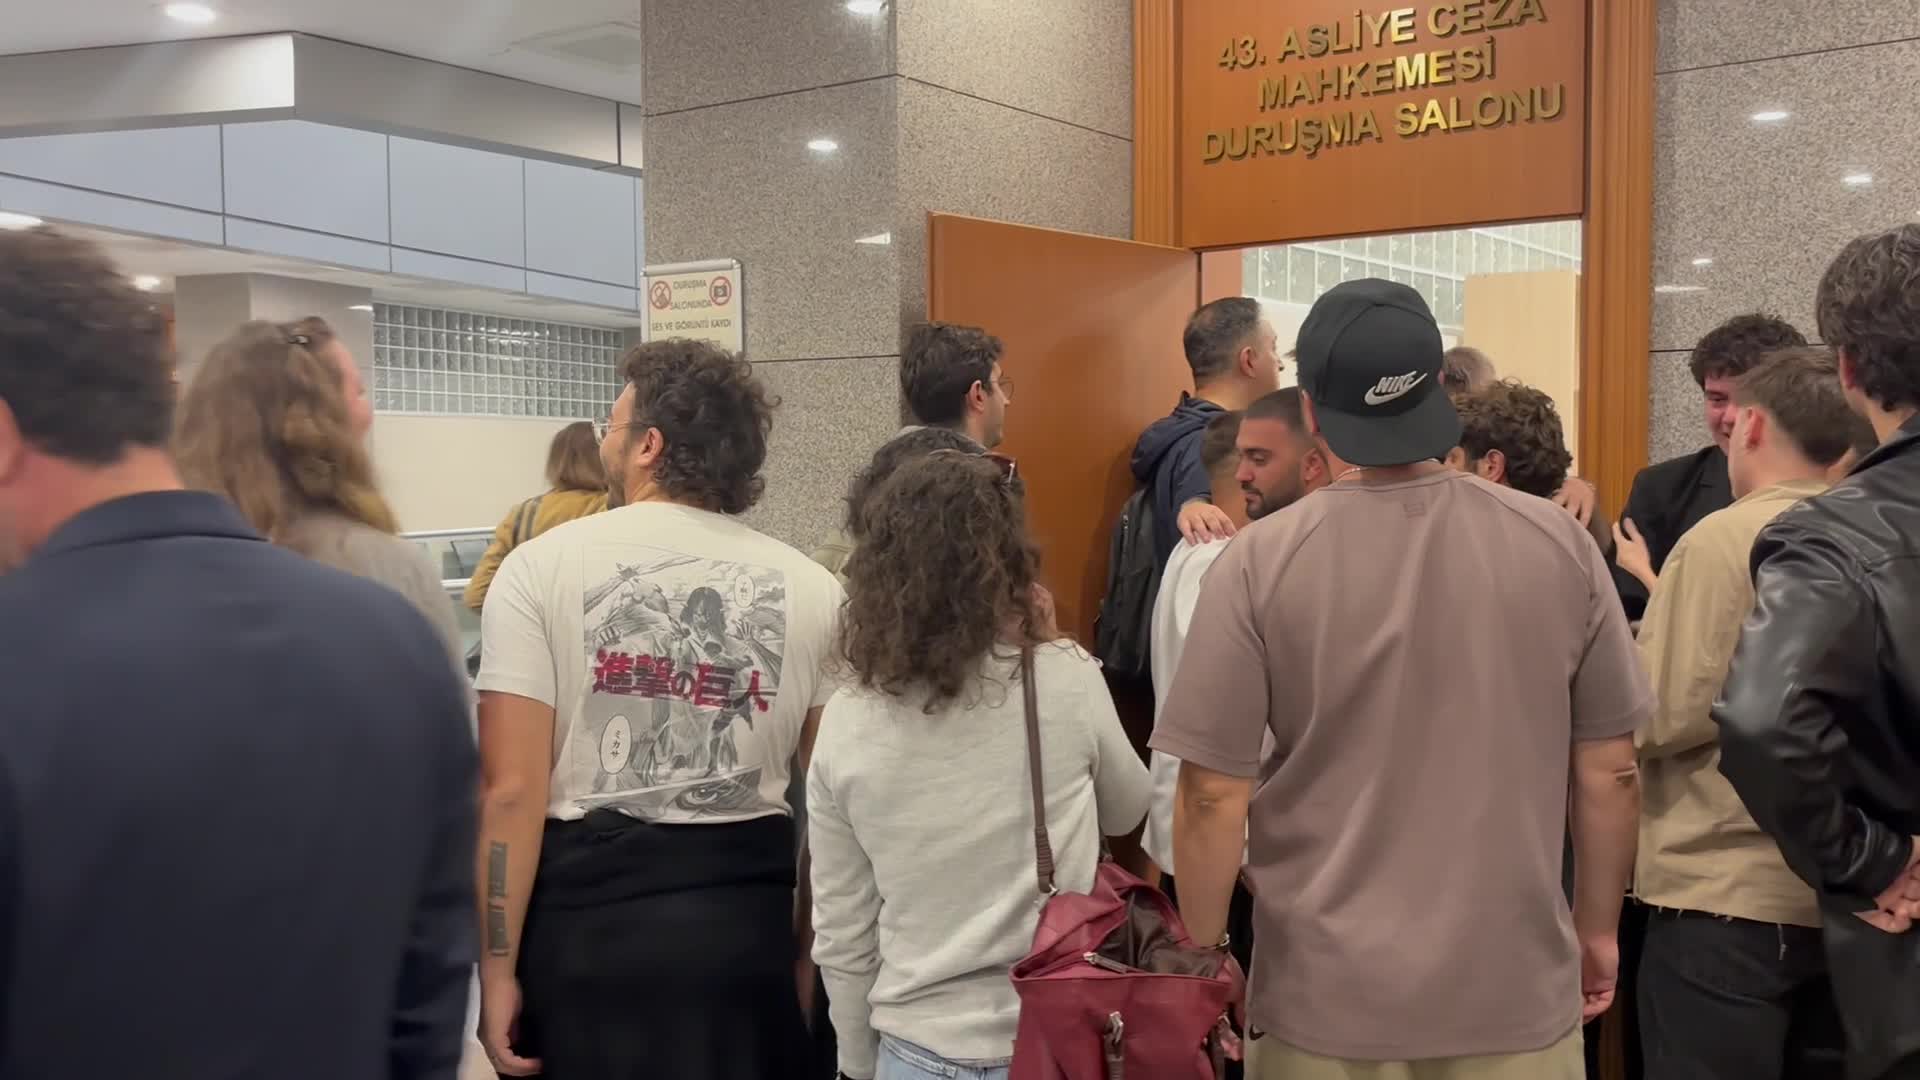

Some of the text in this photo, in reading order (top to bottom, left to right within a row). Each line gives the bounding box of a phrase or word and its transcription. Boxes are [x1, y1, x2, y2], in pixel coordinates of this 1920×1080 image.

[1217, 0, 1547, 71] 43. ASLİYE CEZA
[1258, 36, 1497, 111] MAHKEMESİ
[1202, 83, 1565, 162] DURUŞMA SALONU
[665, 321, 673, 331] VE
[1375, 370, 1417, 393] NIKE
[592, 648, 769, 712] 進撃の巨人
